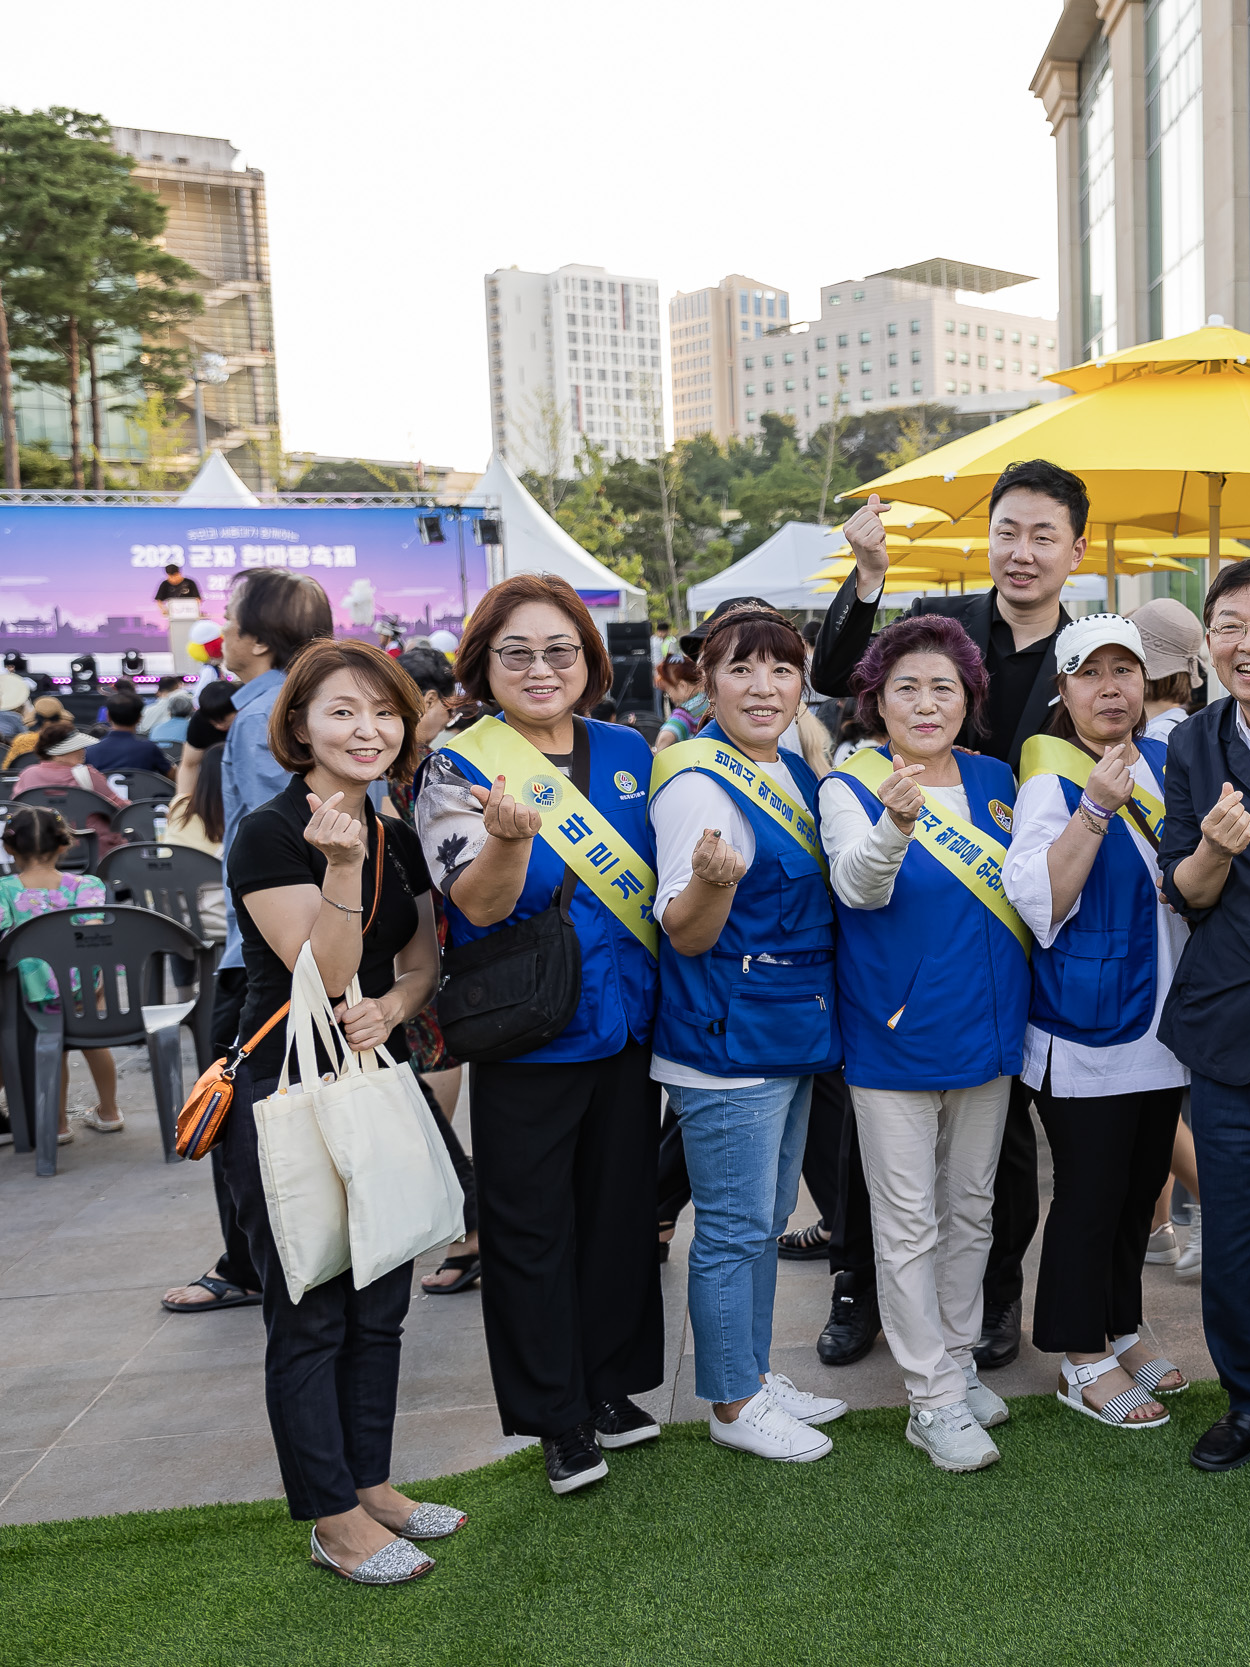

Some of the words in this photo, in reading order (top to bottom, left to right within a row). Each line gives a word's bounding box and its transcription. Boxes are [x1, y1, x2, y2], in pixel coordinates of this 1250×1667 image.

[130, 544, 186, 568] 2023
[188, 544, 236, 568] 군자
[240, 543, 357, 569] 한마당축제
[714, 749, 756, 788] 법질서
[757, 780, 794, 823] 확립을
[934, 826, 984, 867] 확립을
